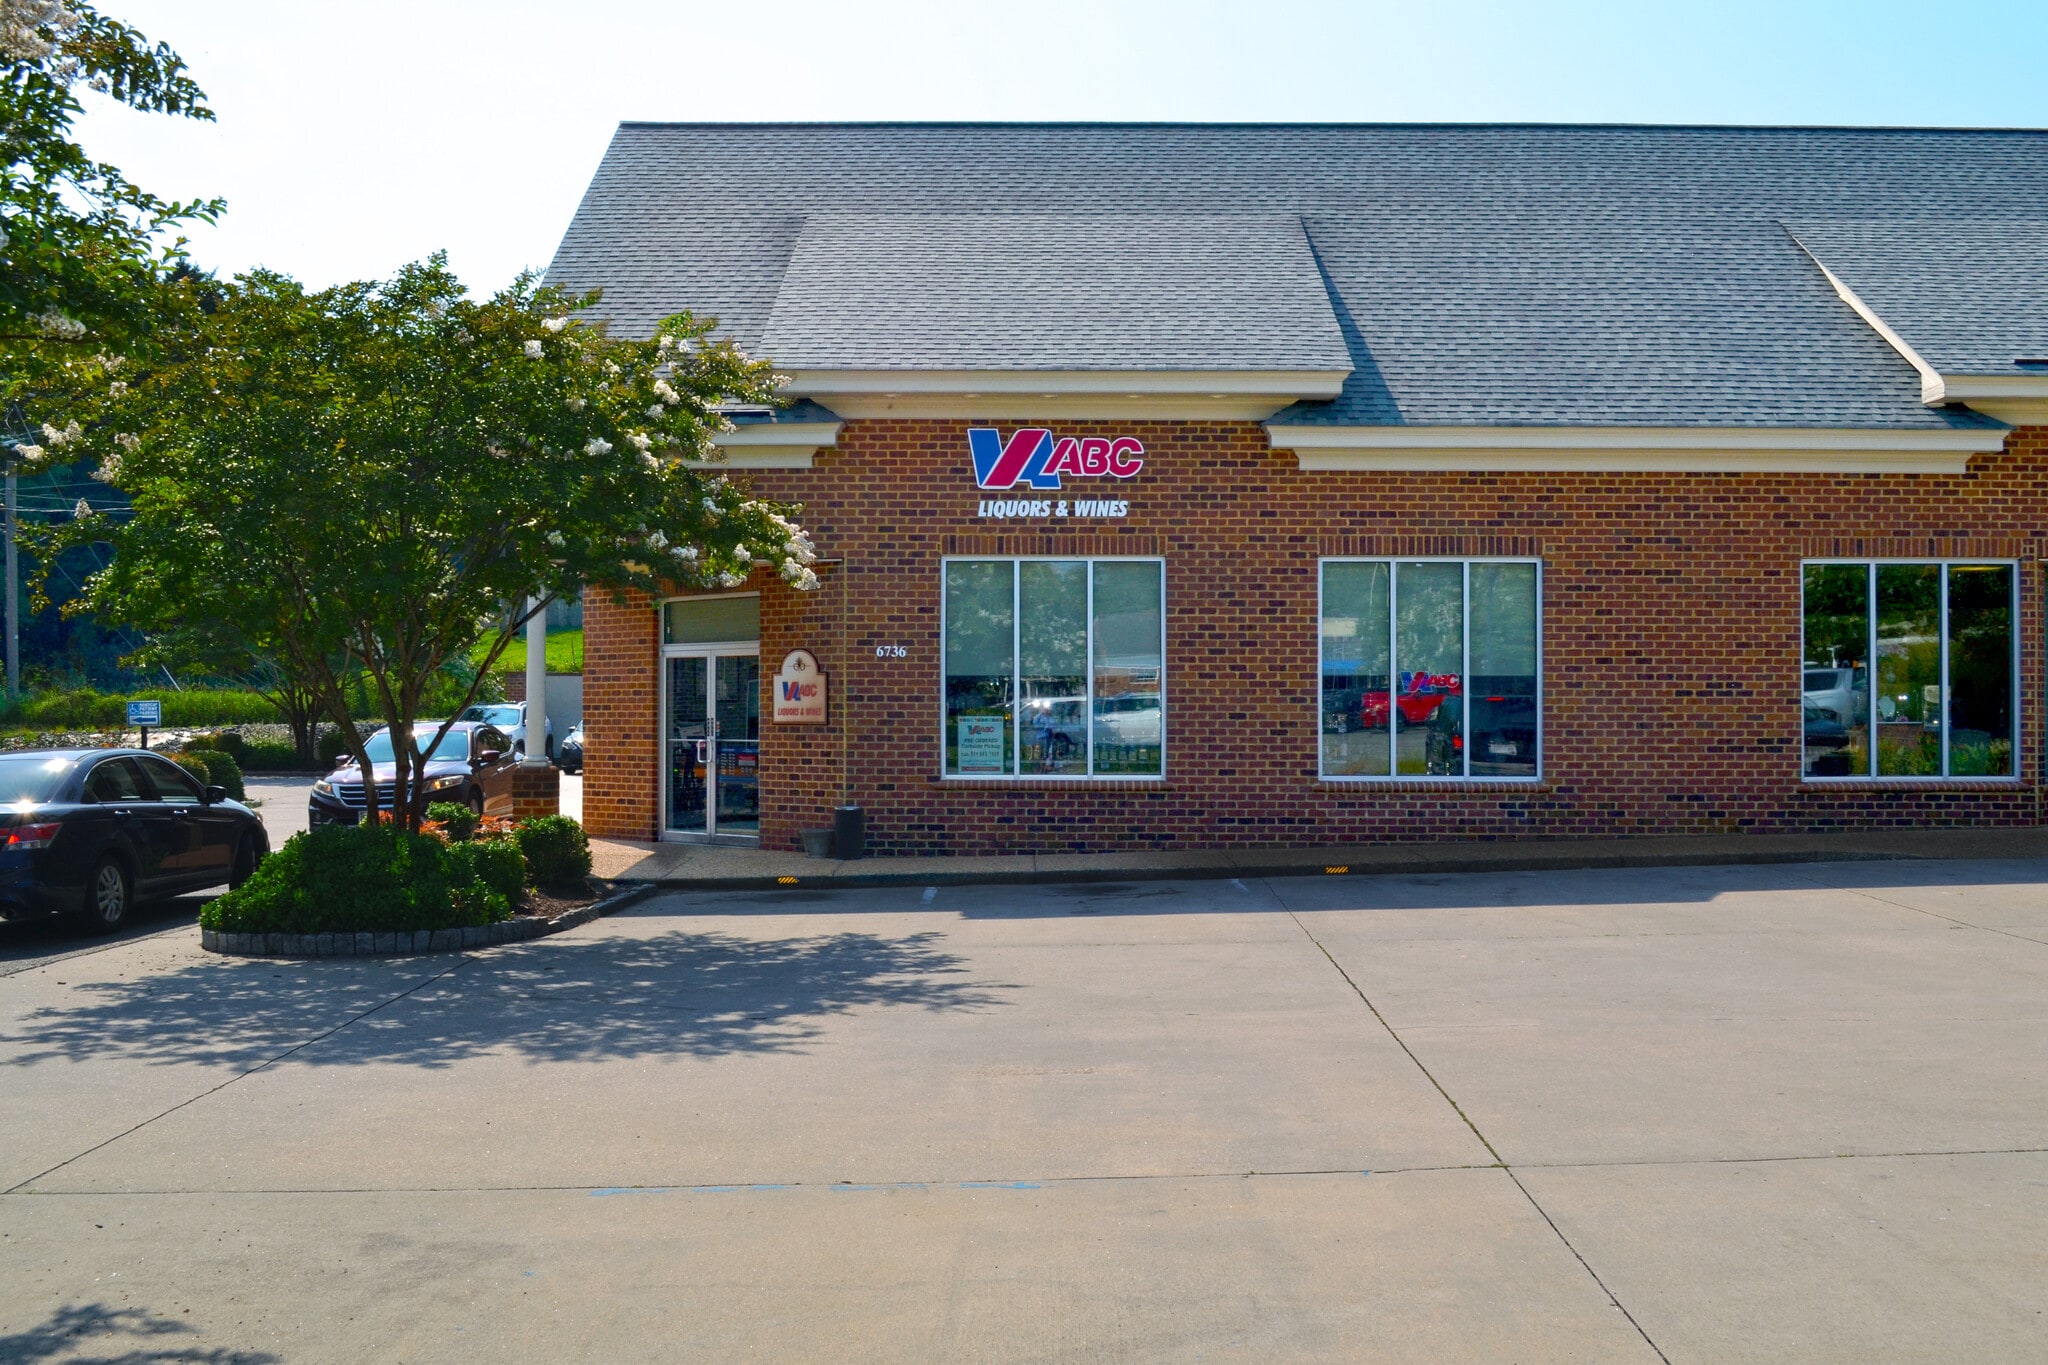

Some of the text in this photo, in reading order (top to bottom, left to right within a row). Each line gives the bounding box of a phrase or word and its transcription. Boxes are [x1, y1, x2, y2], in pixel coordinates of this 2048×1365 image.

[1038, 437, 1144, 477] ABC
[978, 500, 1128, 519] LIQUORS & WINES
[876, 646, 907, 657] 6736
[1427, 673, 1460, 688] ABC
[799, 684, 817, 697] ABC
[778, 707, 800, 717] LIQUORS
